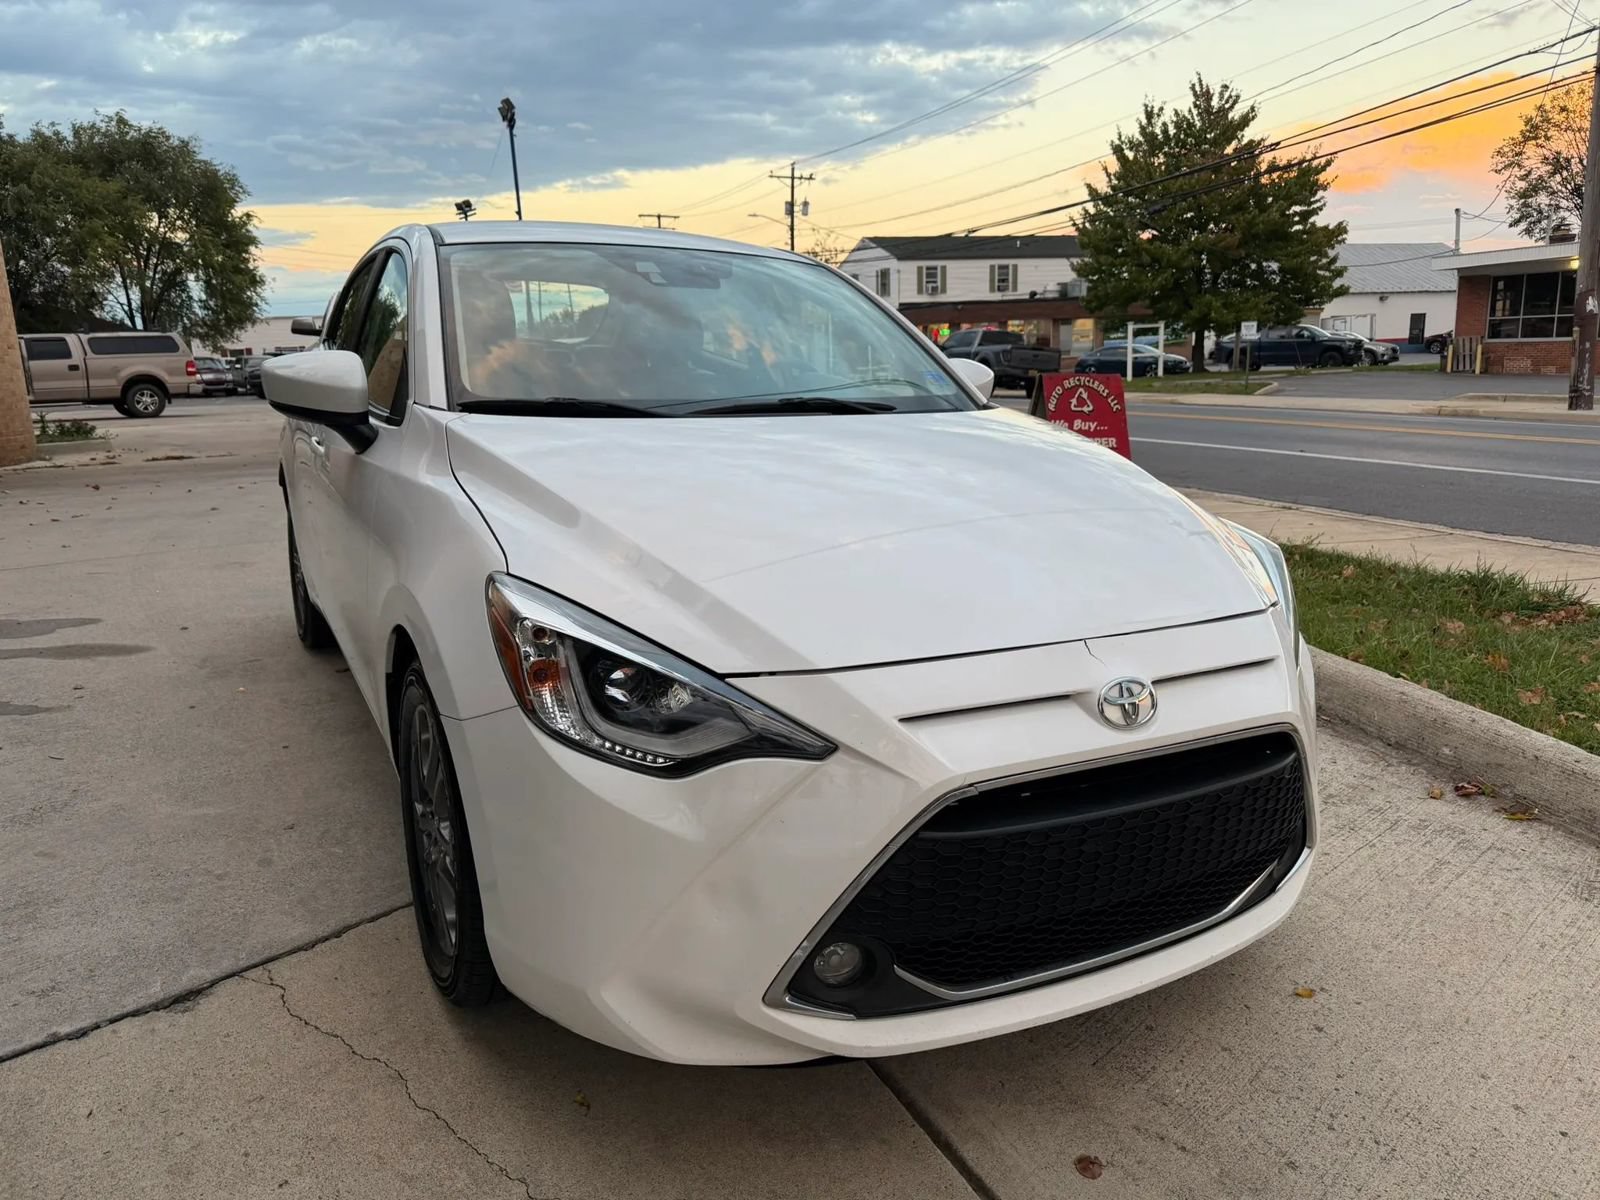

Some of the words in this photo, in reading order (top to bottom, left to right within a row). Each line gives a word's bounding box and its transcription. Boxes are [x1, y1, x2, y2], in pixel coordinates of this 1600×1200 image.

[1048, 385, 1063, 411] AUTO
[1063, 376, 1109, 398] RECYCLERS
[1107, 395, 1121, 412] LLC
